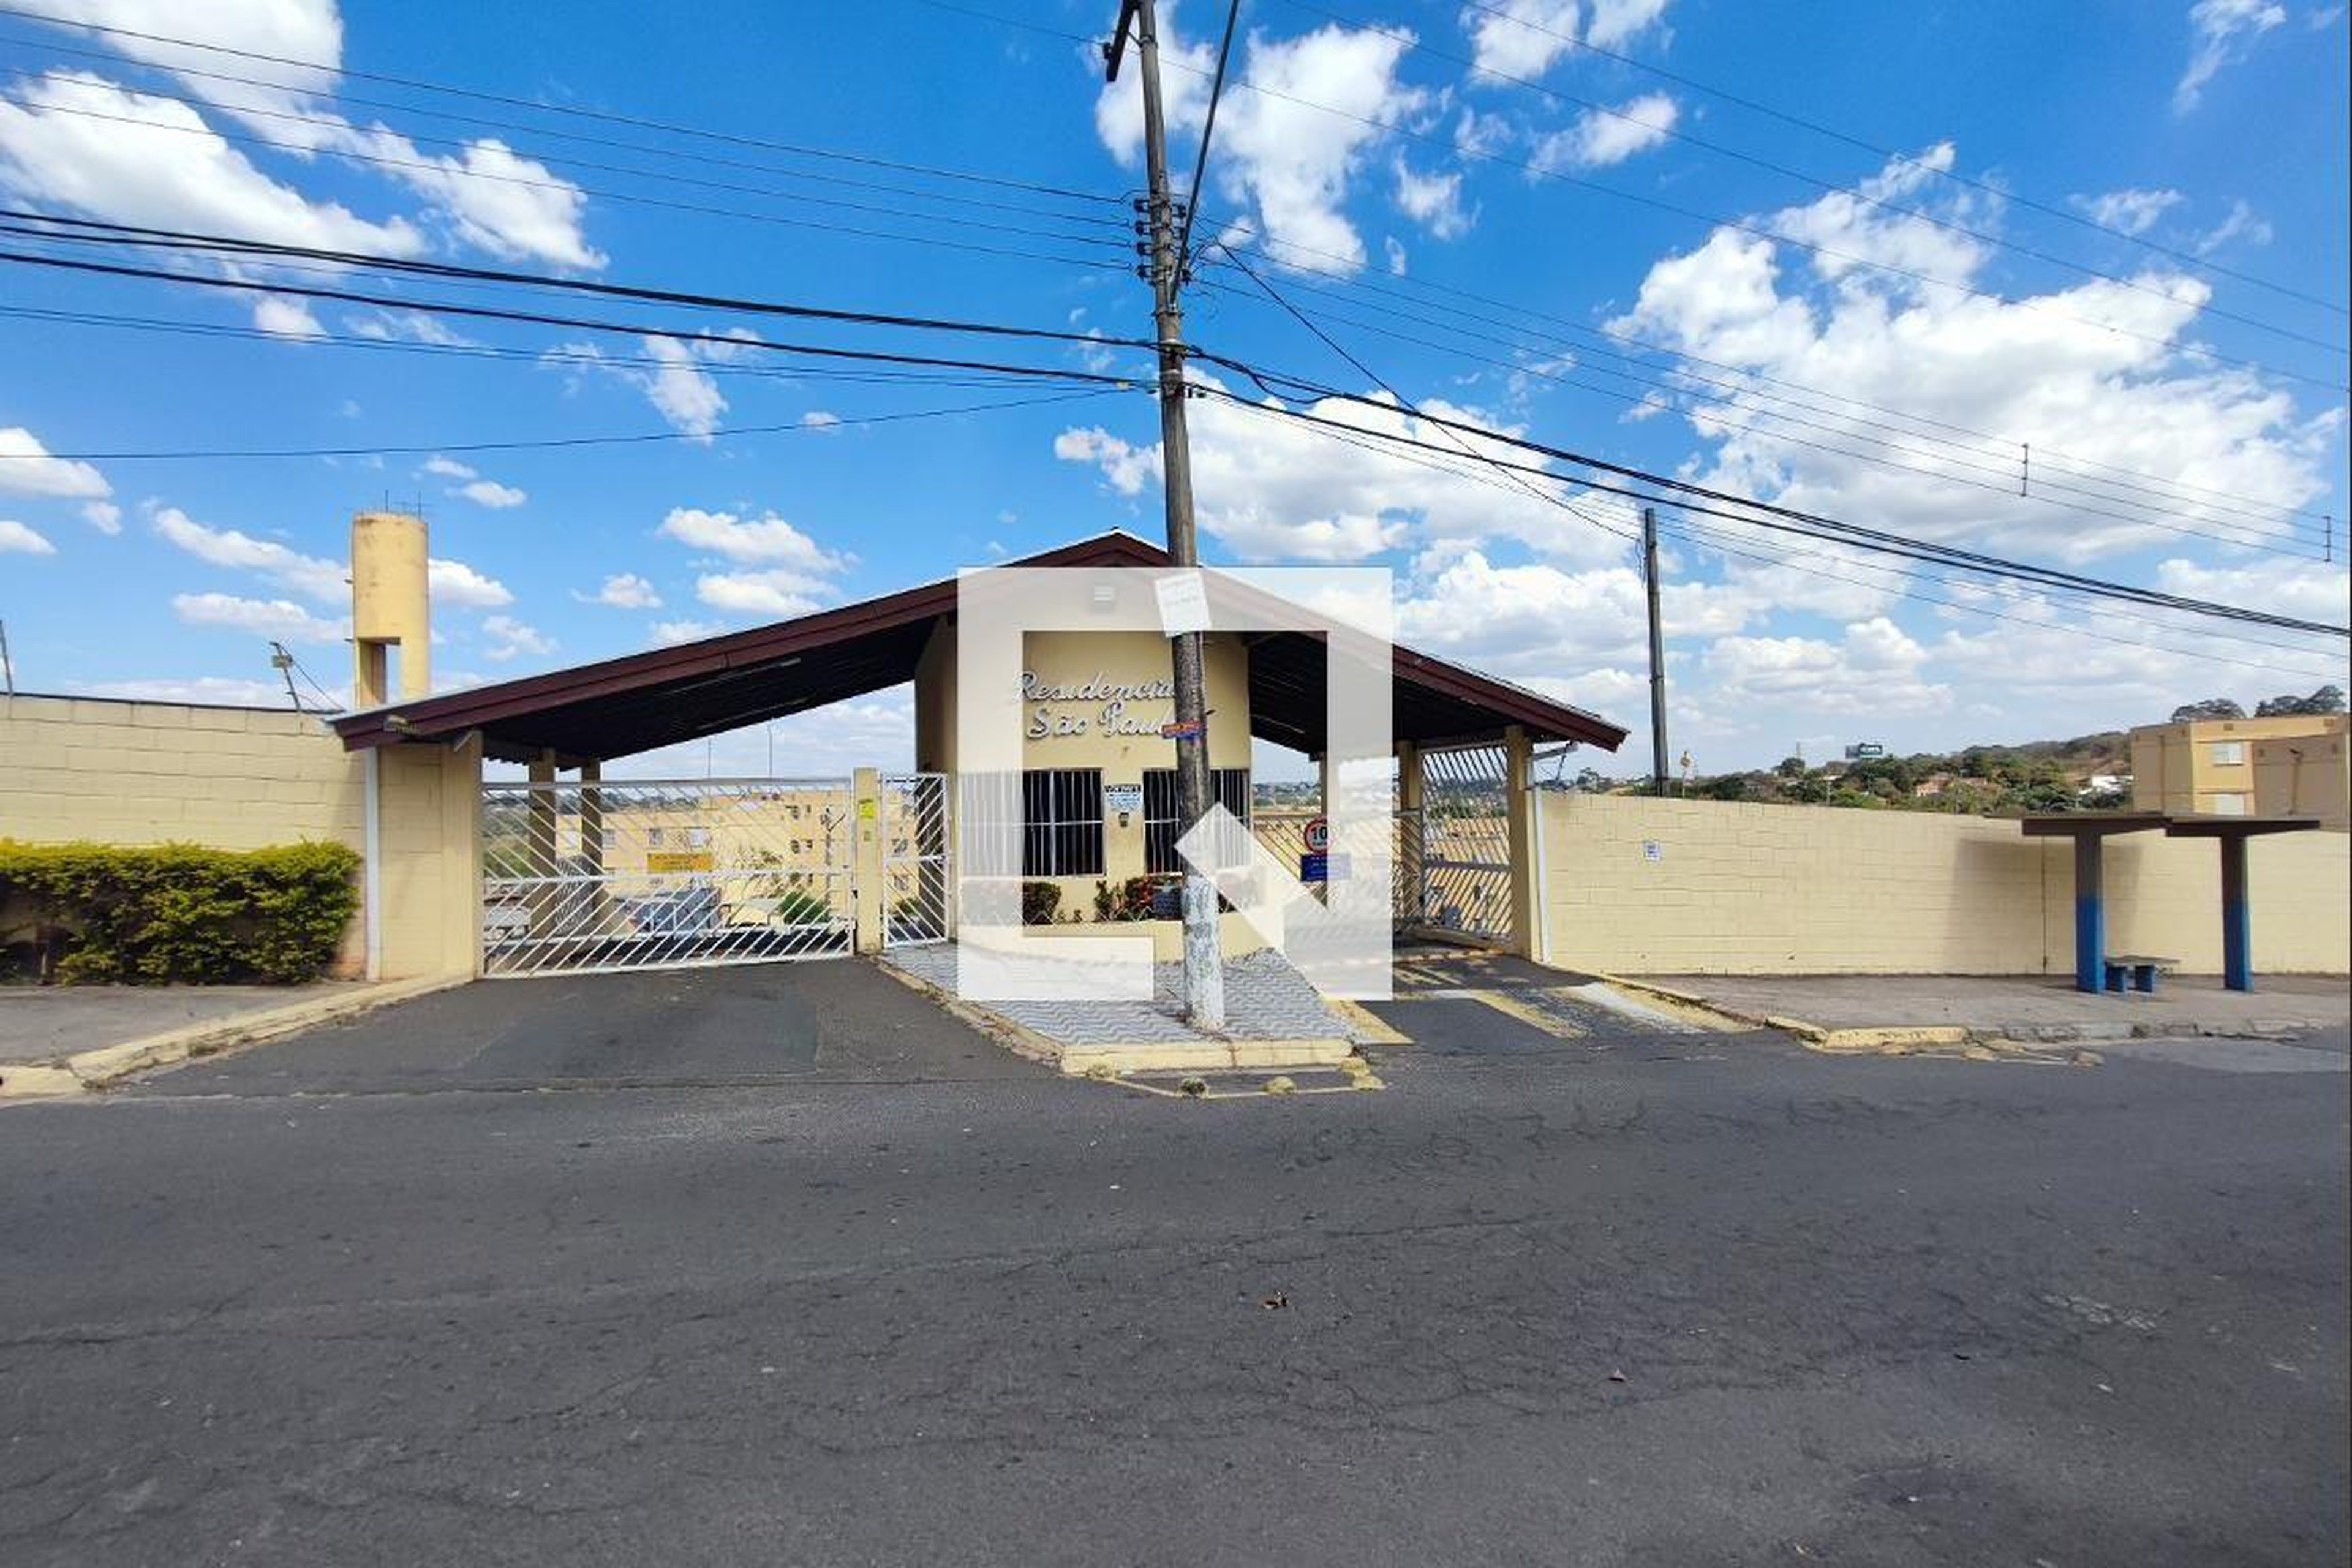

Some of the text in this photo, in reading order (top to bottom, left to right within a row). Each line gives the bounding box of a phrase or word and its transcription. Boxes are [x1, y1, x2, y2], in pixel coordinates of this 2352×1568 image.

[1013, 670, 1176, 702] Residencia
[1027, 707, 1088, 740] São
[1097, 699, 1175, 737] Paul
[1311, 826, 1328, 840] 10
